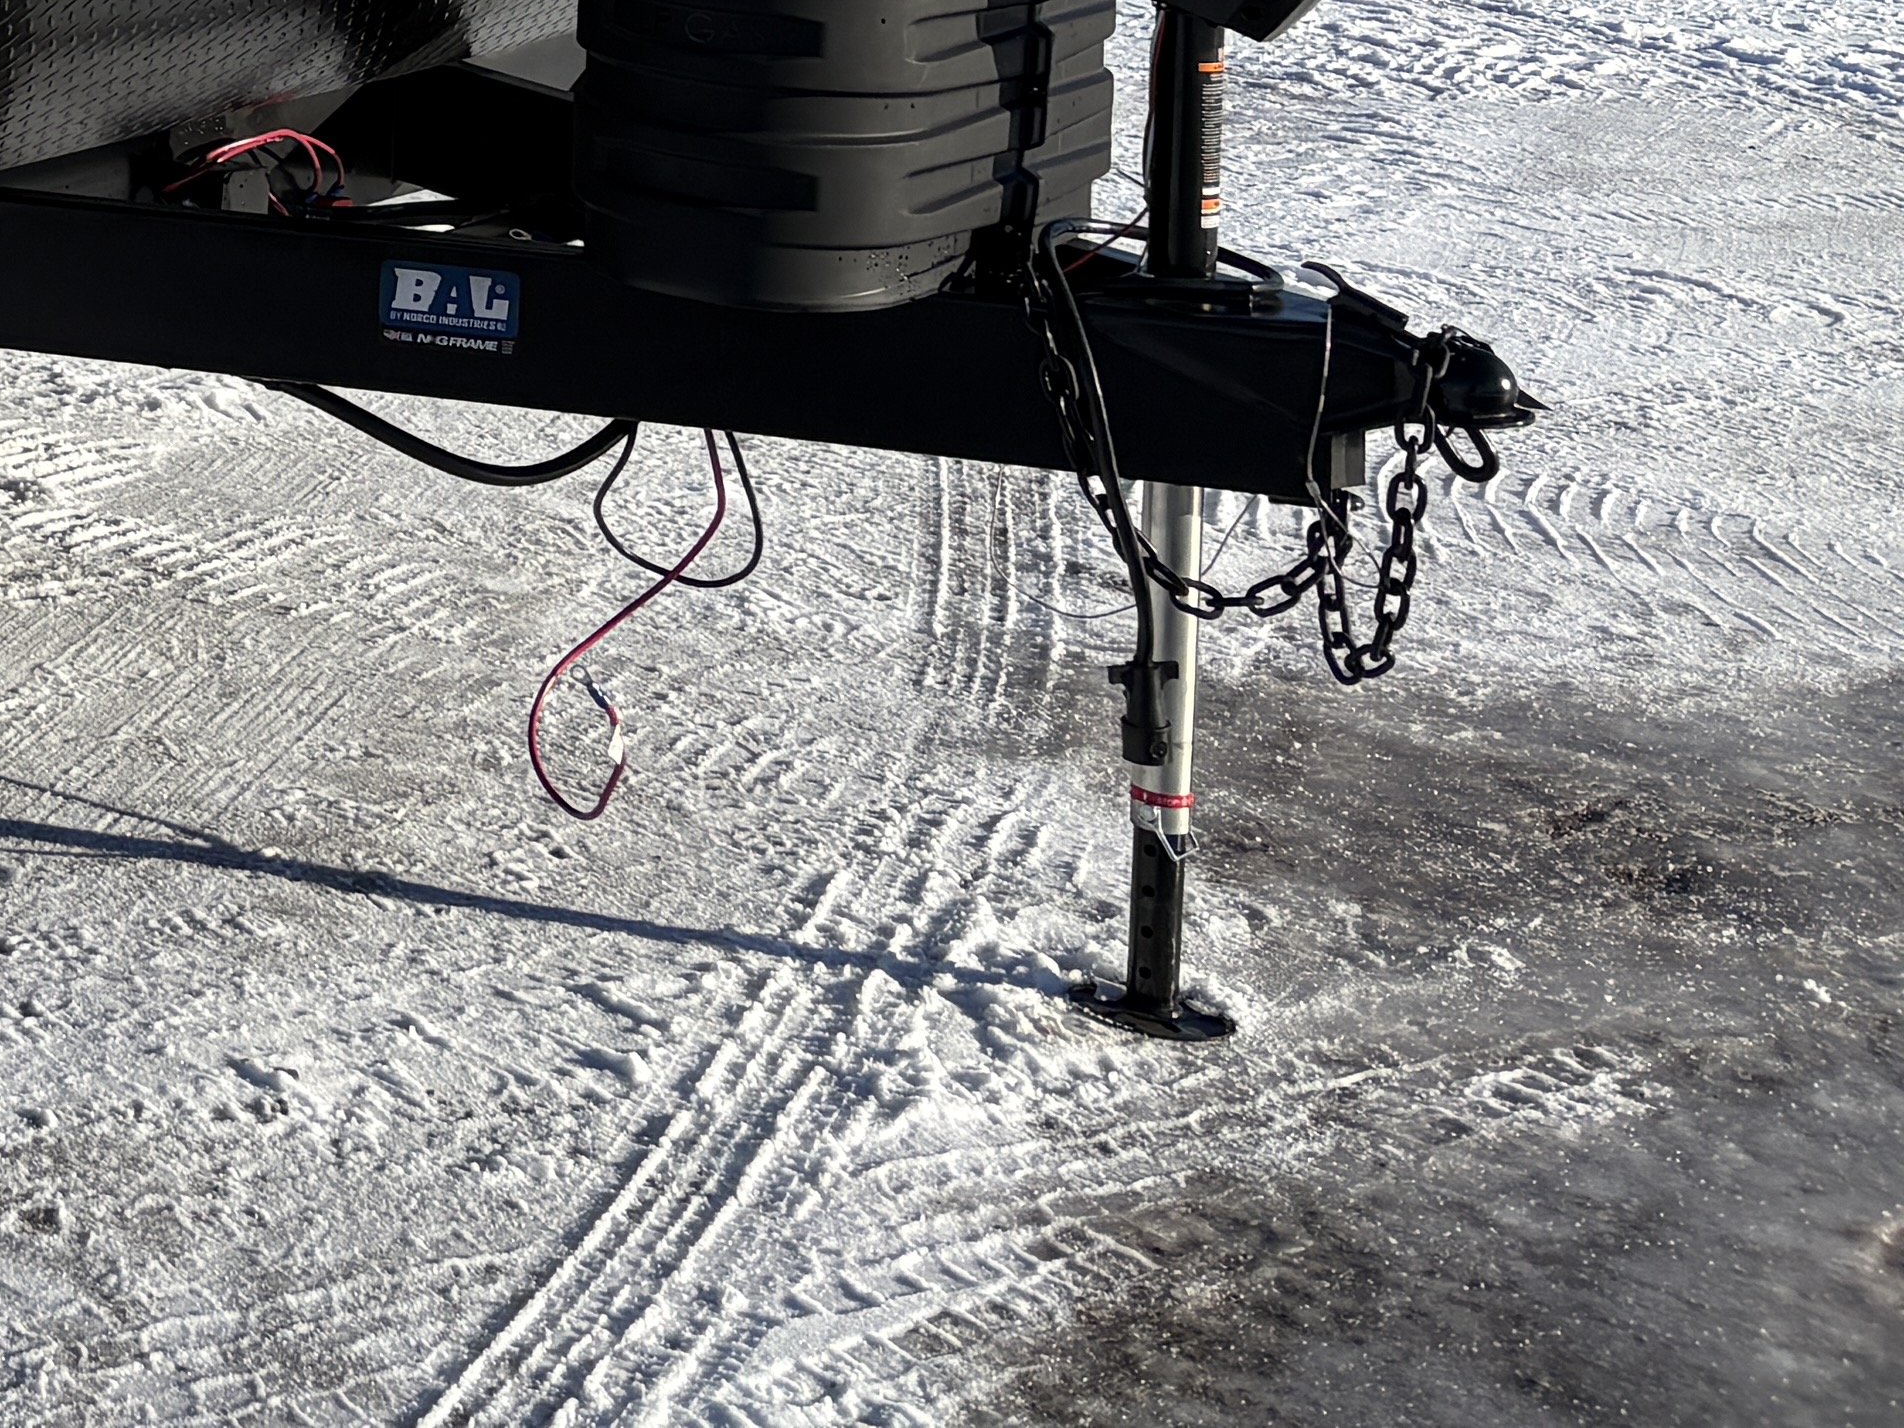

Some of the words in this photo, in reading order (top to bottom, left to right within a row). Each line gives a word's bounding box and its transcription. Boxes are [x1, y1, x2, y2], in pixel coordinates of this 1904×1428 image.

[391, 267, 510, 321] BAL
[390, 310, 402, 320] BY
[403, 312, 437, 324] NORCO
[438, 316, 496, 331] INDUSTRIES
